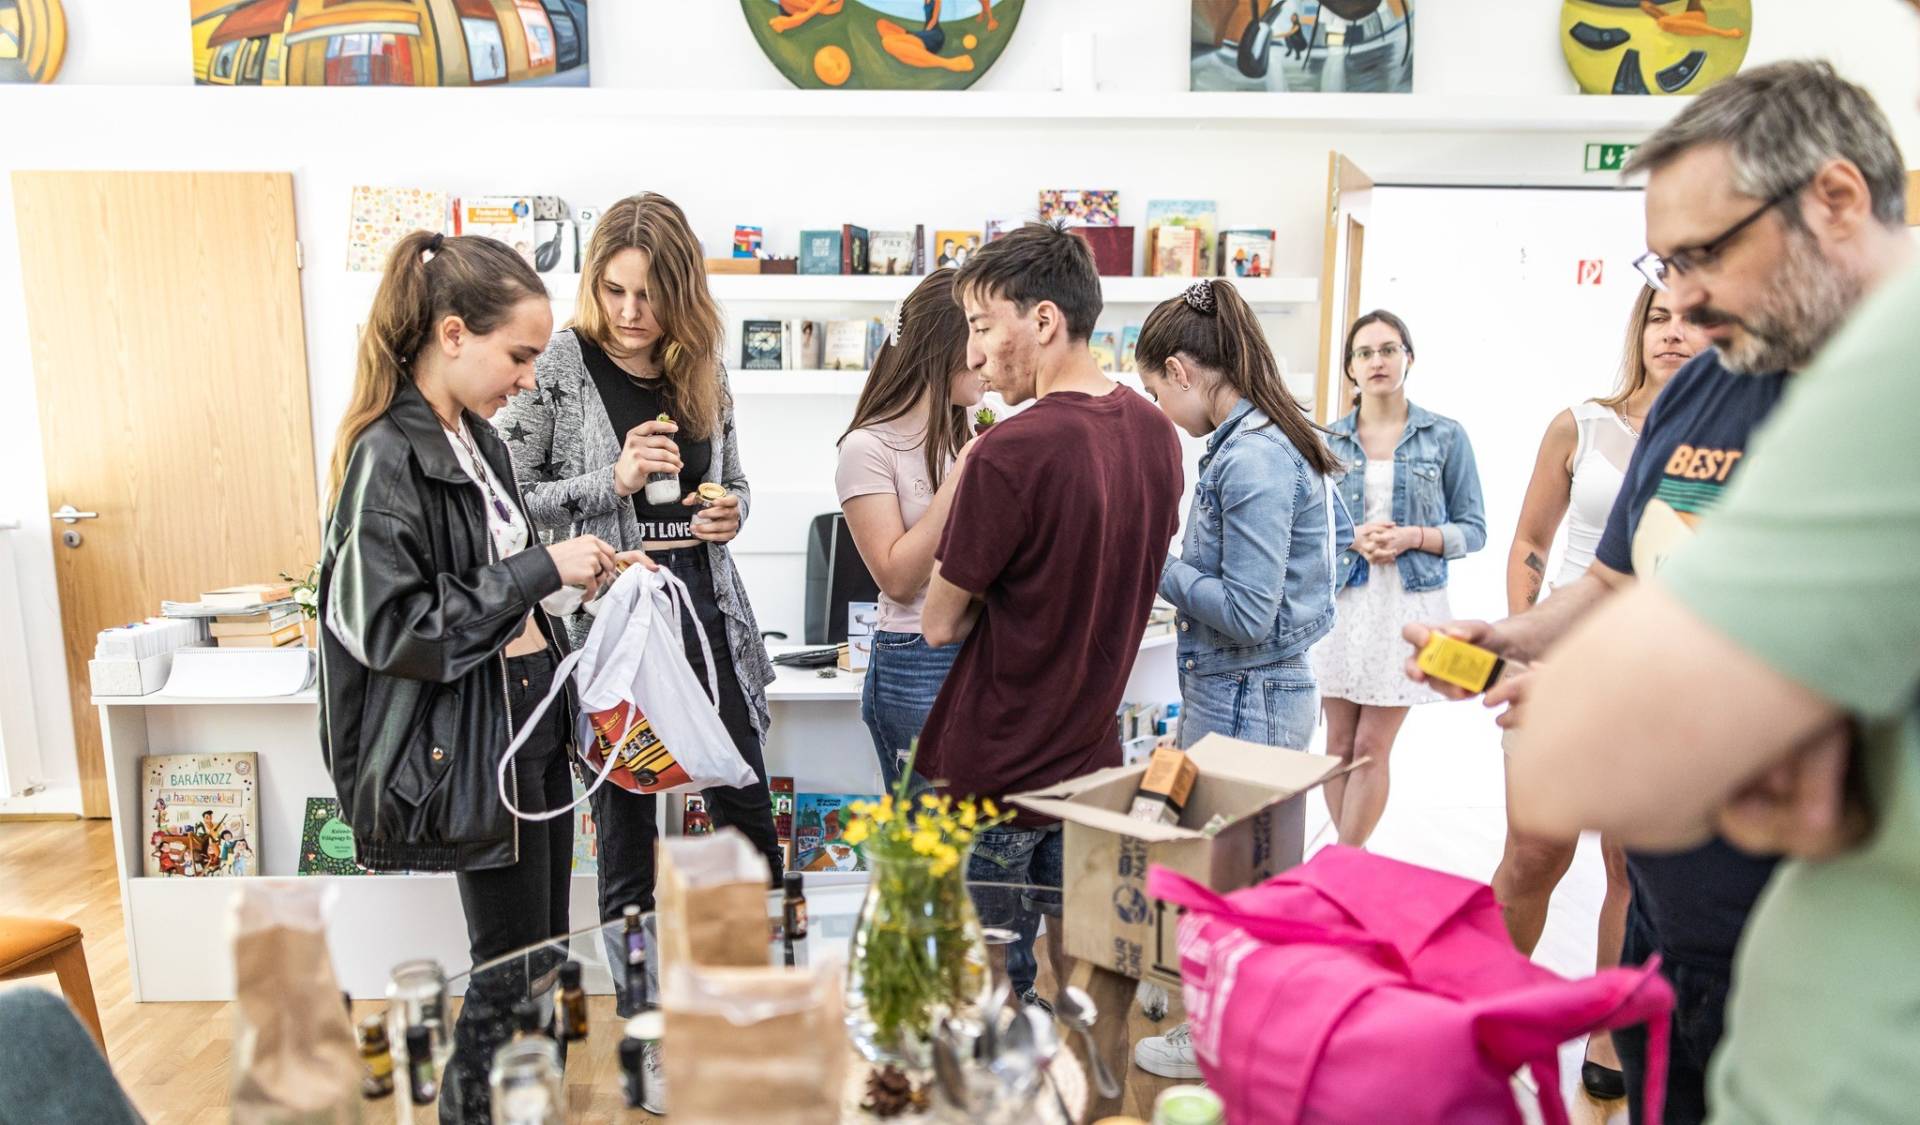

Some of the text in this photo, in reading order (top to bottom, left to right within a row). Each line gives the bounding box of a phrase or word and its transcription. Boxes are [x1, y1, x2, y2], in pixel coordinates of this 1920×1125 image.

[1665, 444, 1743, 481] BEST
[659, 521, 692, 538] LOVE
[170, 772, 232, 786] BARÁTKOZZ
